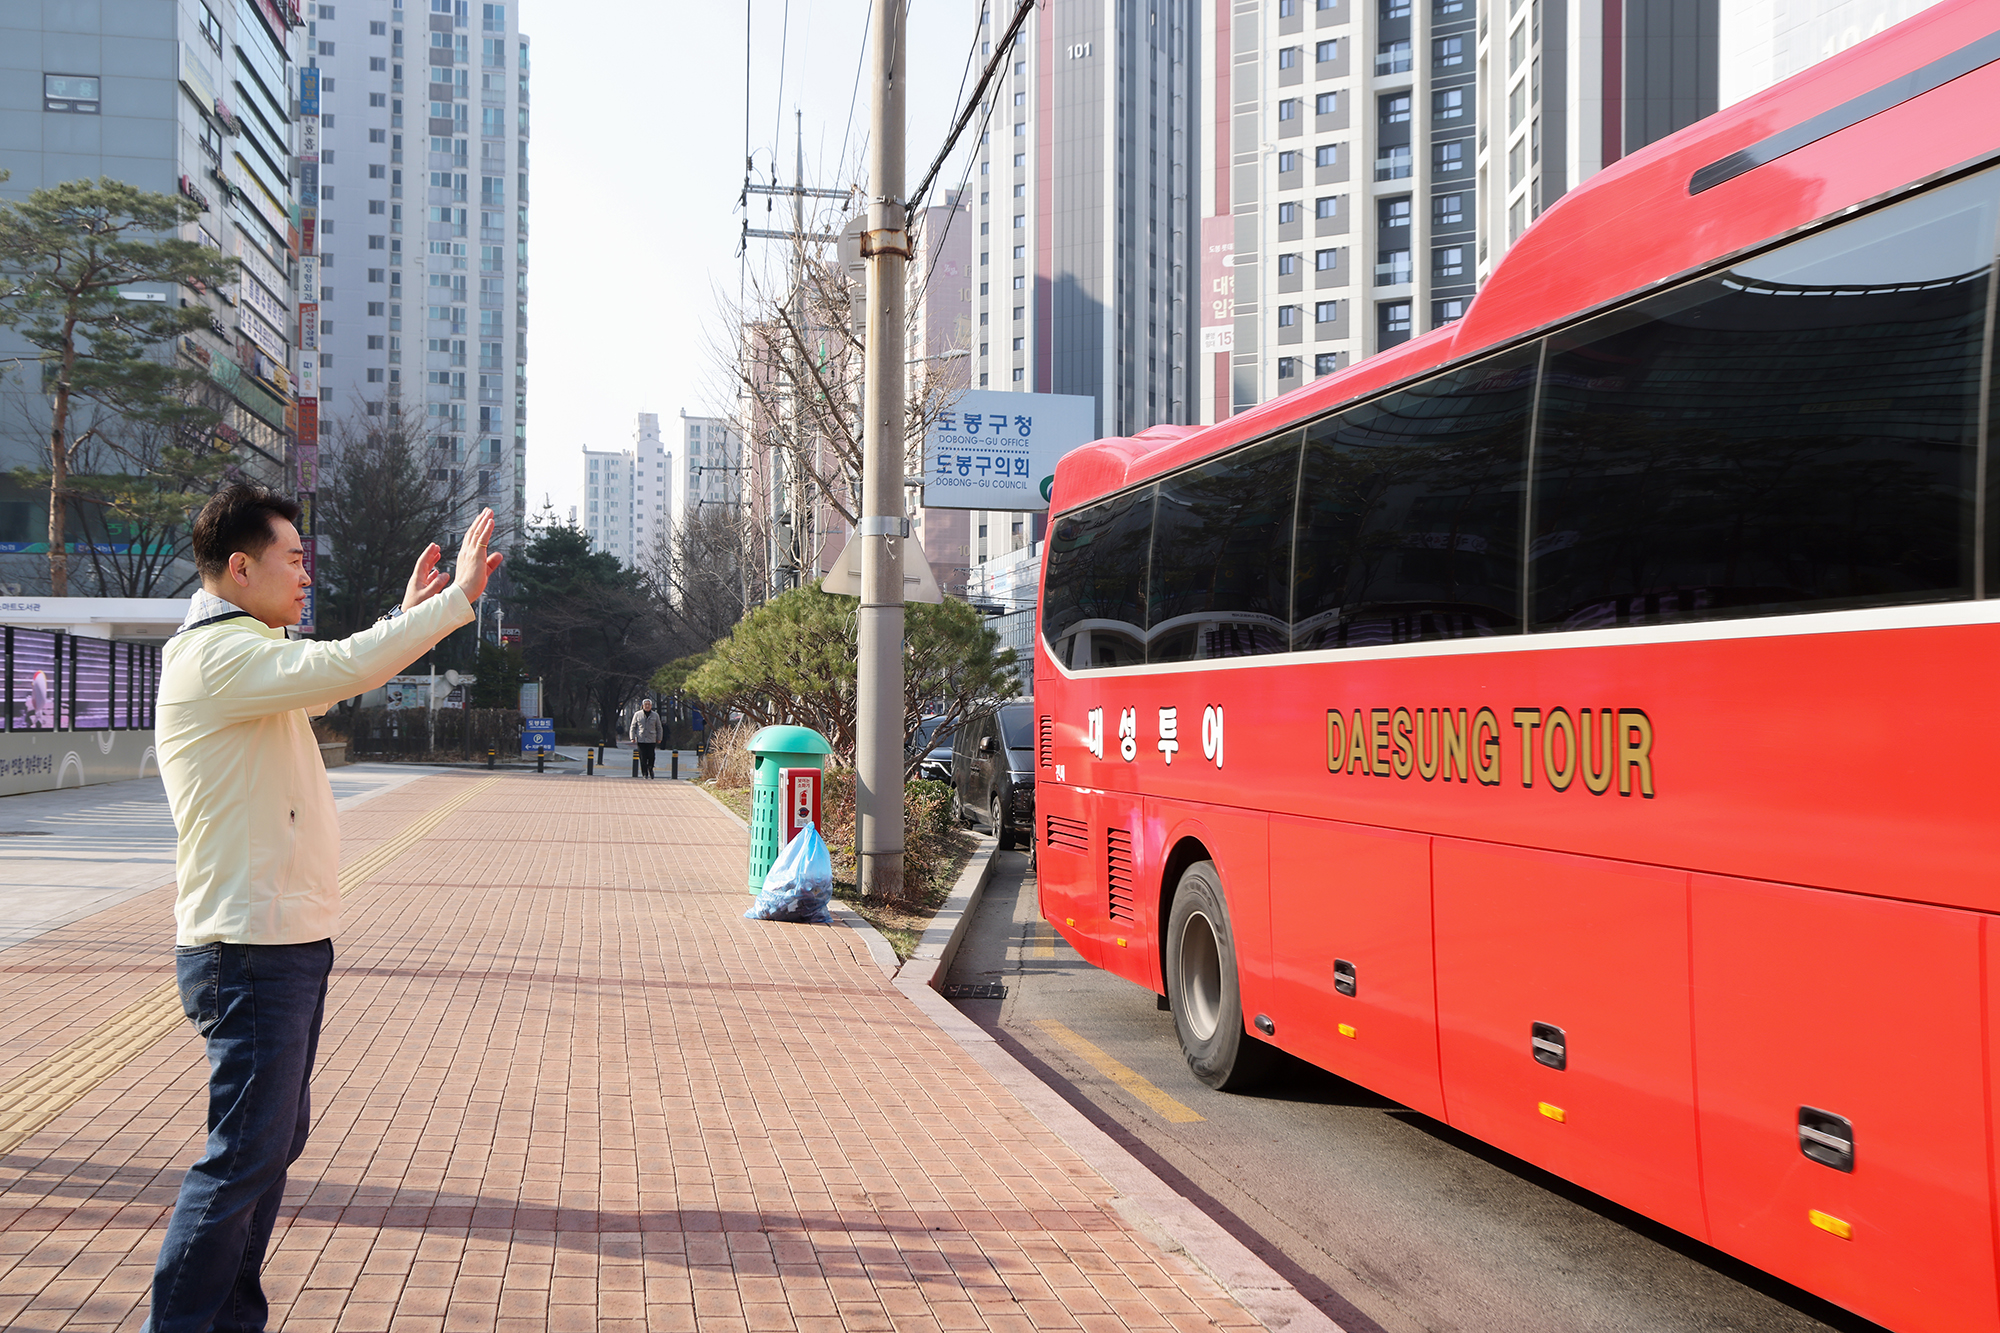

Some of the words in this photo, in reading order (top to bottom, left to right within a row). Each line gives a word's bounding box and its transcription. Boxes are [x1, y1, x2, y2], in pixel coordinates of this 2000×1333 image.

[1067, 42, 1092, 60] 101
[1217, 331, 1234, 346] 15
[938, 412, 1032, 437] 도봉구청
[939, 434, 998, 446] DOBONG-GU
[1000, 437, 1029, 447] OFFICE
[936, 454, 1029, 478] 도봉구의회
[936, 477, 990, 487] DOBONG-GU
[992, 479, 1027, 489] COUNCIL
[1088, 703, 1224, 770] 대성투어
[1327, 706, 1500, 787] DAESUNG
[1513, 706, 1654, 799] TOUR
